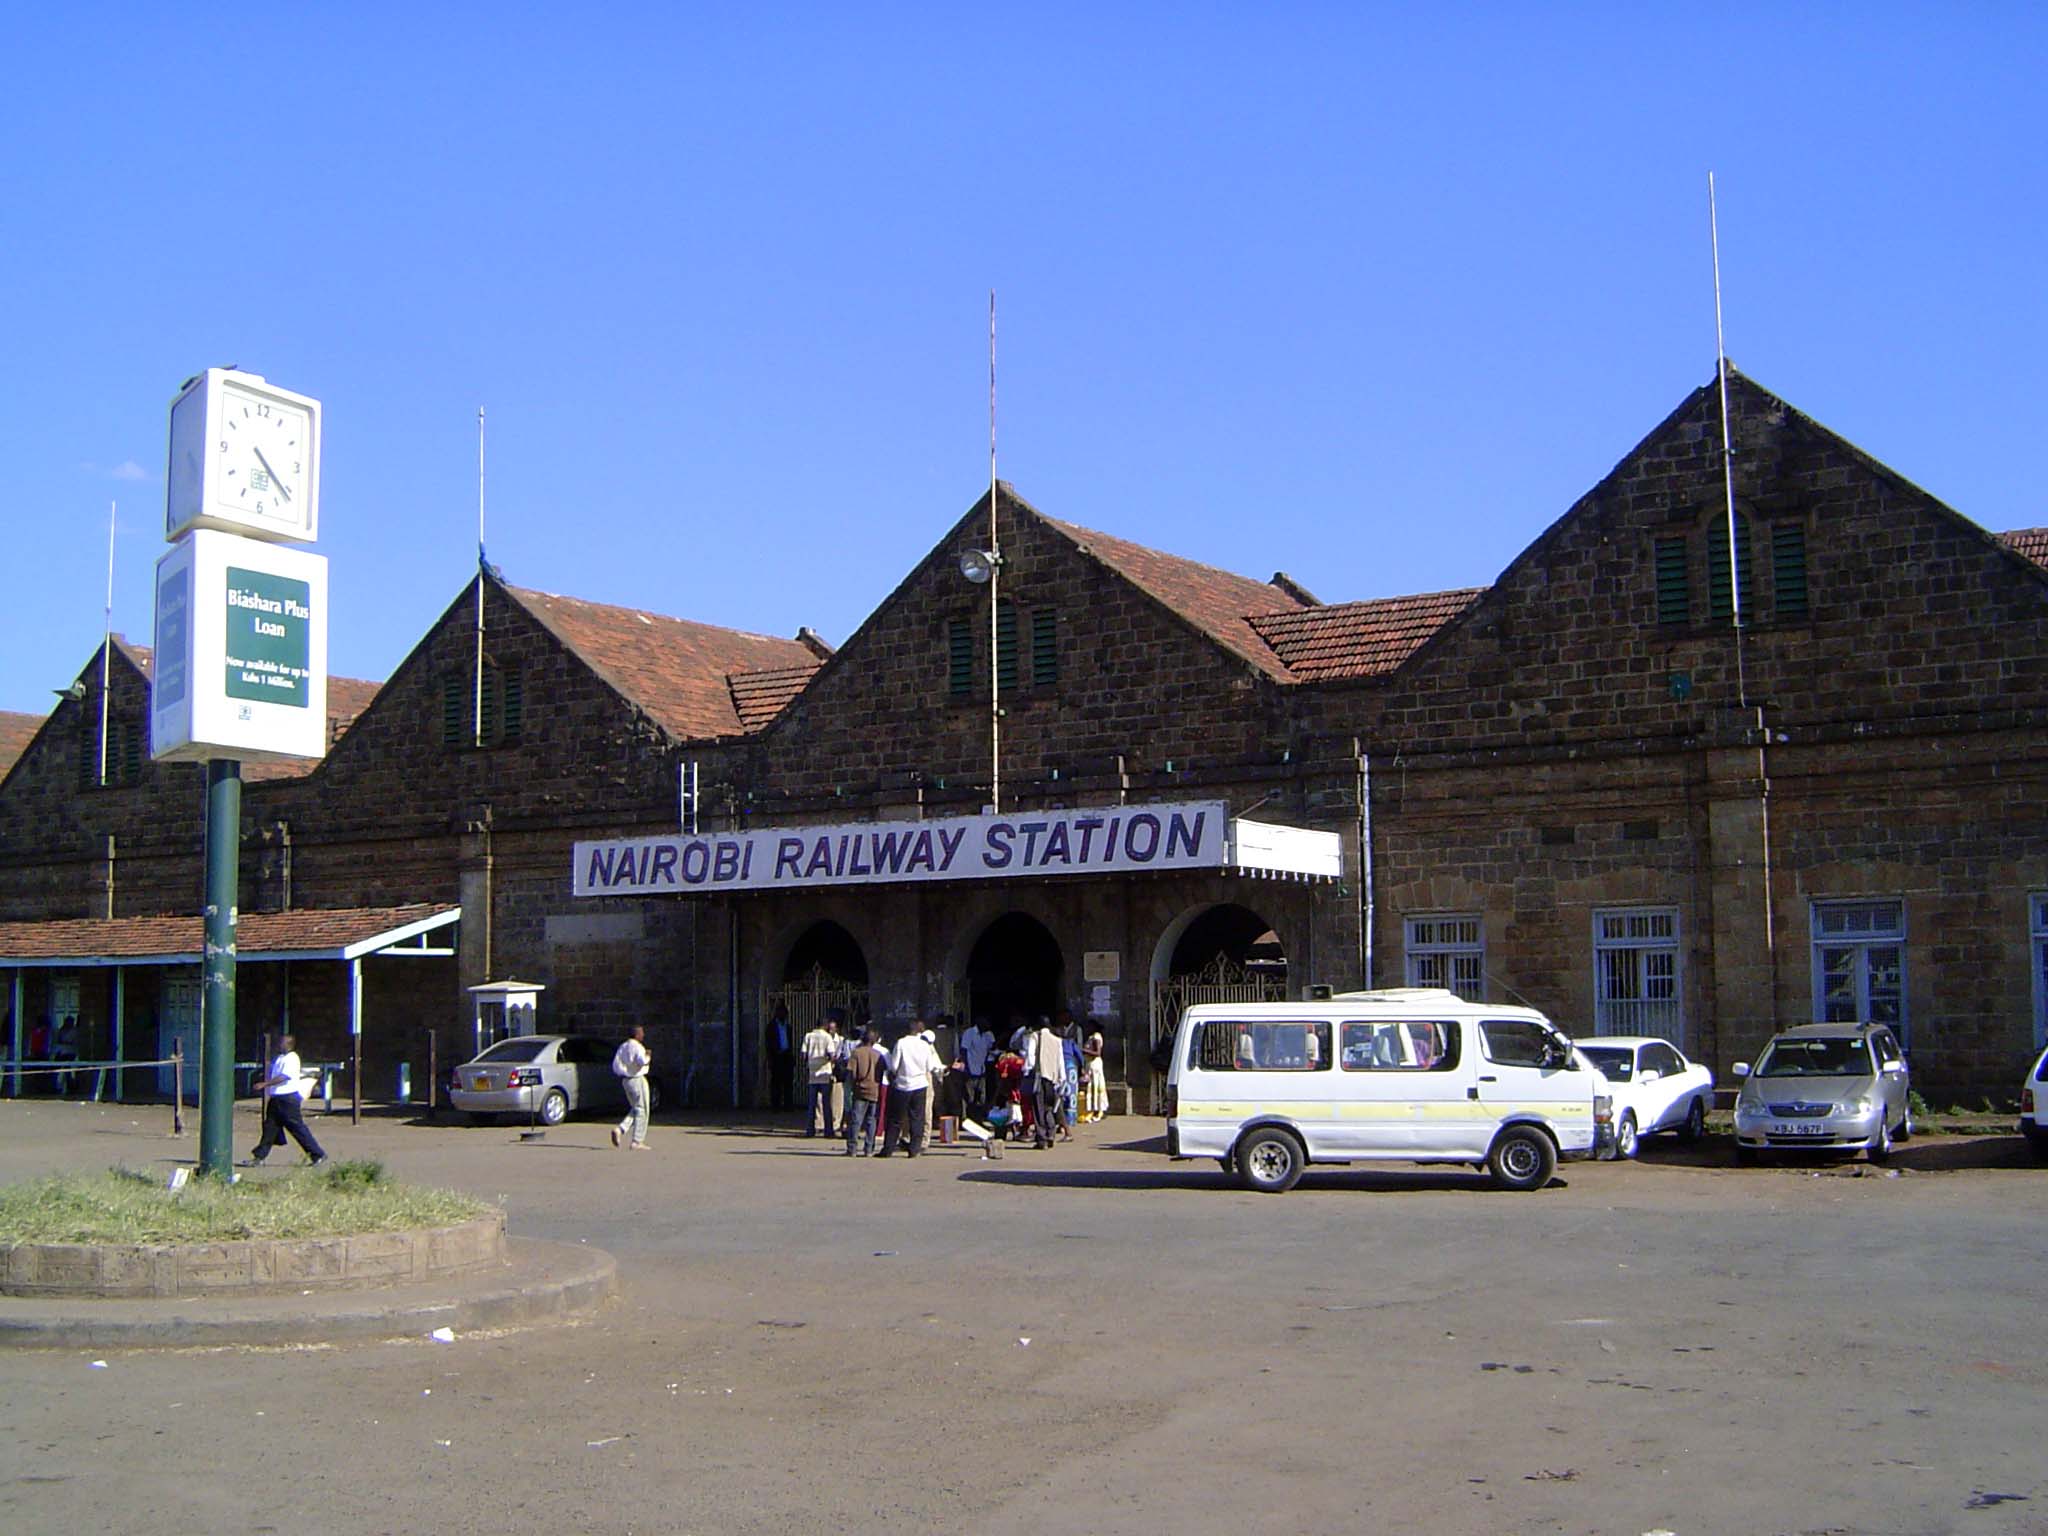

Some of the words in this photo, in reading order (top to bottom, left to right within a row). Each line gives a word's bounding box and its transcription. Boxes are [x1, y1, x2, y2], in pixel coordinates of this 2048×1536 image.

[257, 403, 270, 418] 12
[220, 441, 228, 453] 9
[294, 461, 301, 474] 3
[256, 501, 263, 514] 6
[228, 589, 282, 614] Biashara
[284, 599, 309, 619] Plus
[255, 617, 285, 637] Loan
[588, 840, 753, 887] NAIROBI
[775, 827, 966, 879] RAILWAY
[982, 812, 1205, 868] STATION
